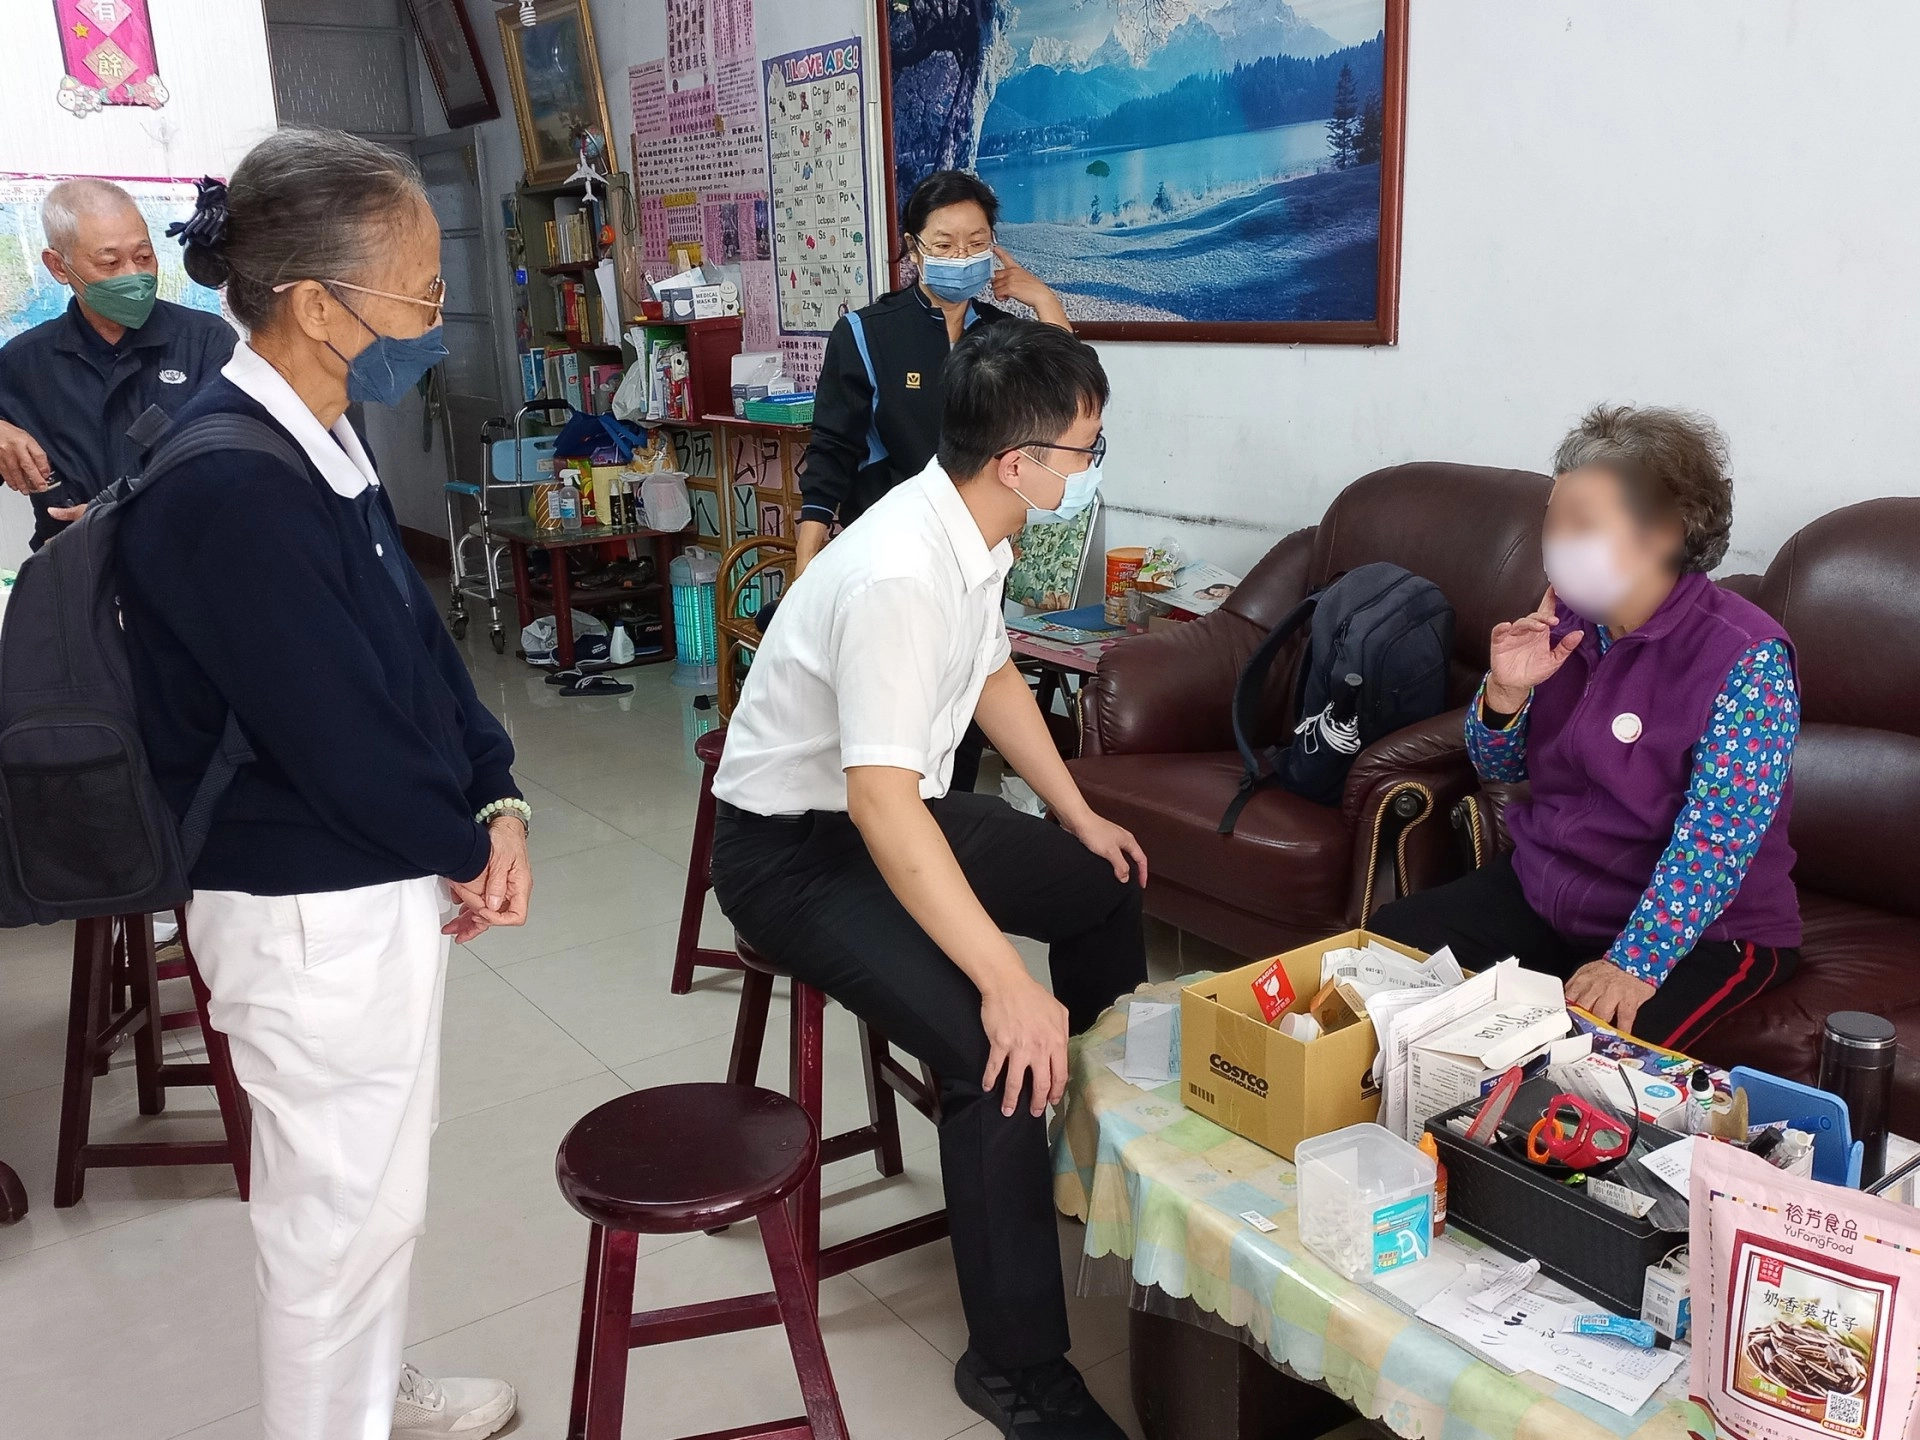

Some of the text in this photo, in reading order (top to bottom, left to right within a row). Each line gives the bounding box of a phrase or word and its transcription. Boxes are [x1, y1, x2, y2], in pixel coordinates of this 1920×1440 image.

[785, 45, 859, 82] I LOVE ABC!
[835, 80, 845, 91] Dd
[788, 91, 796, 101] Bb
[812, 86, 821, 96] Cc
[836, 104, 846, 112] dog
[815, 121, 822, 133] Gg
[837, 118, 846, 128] Hh
[770, 129, 778, 139] Ee
[791, 125, 797, 136] Ff
[772, 150, 790, 160] elephant
[794, 161, 800, 173] Jj
[815, 159, 823, 168] Kk
[839, 179, 847, 187] leg
[794, 184, 808, 193] jacket
[794, 197, 803, 206] Nn
[816, 195, 825, 204] Oo
[840, 192, 849, 203] Pp
[818, 217, 835, 225] octopus
[840, 215, 850, 223] pen
[797, 232, 804, 240] Rr
[818, 230, 826, 240] Ss
[841, 228, 848, 238] Tt
[777, 234, 786, 244] Qq
[842, 251, 856, 259] turtle
[779, 267, 788, 276] Uu
[801, 266, 809, 275] Vv
[821, 265, 832, 274] Ww
[843, 264, 851, 273] Xx
[803, 301, 810, 309] Zz
[1254, 963, 1279, 987] FRAGILE
[1209, 1053, 1269, 1092] COSTCO
[1227, 1075, 1269, 1099] WHOLESALE
[1785, 1202, 1858, 1241] 裕芳食品
[1784, 1224, 1854, 1255] YuFangFood
[1763, 1289, 1859, 1332] 奶香葵花子
